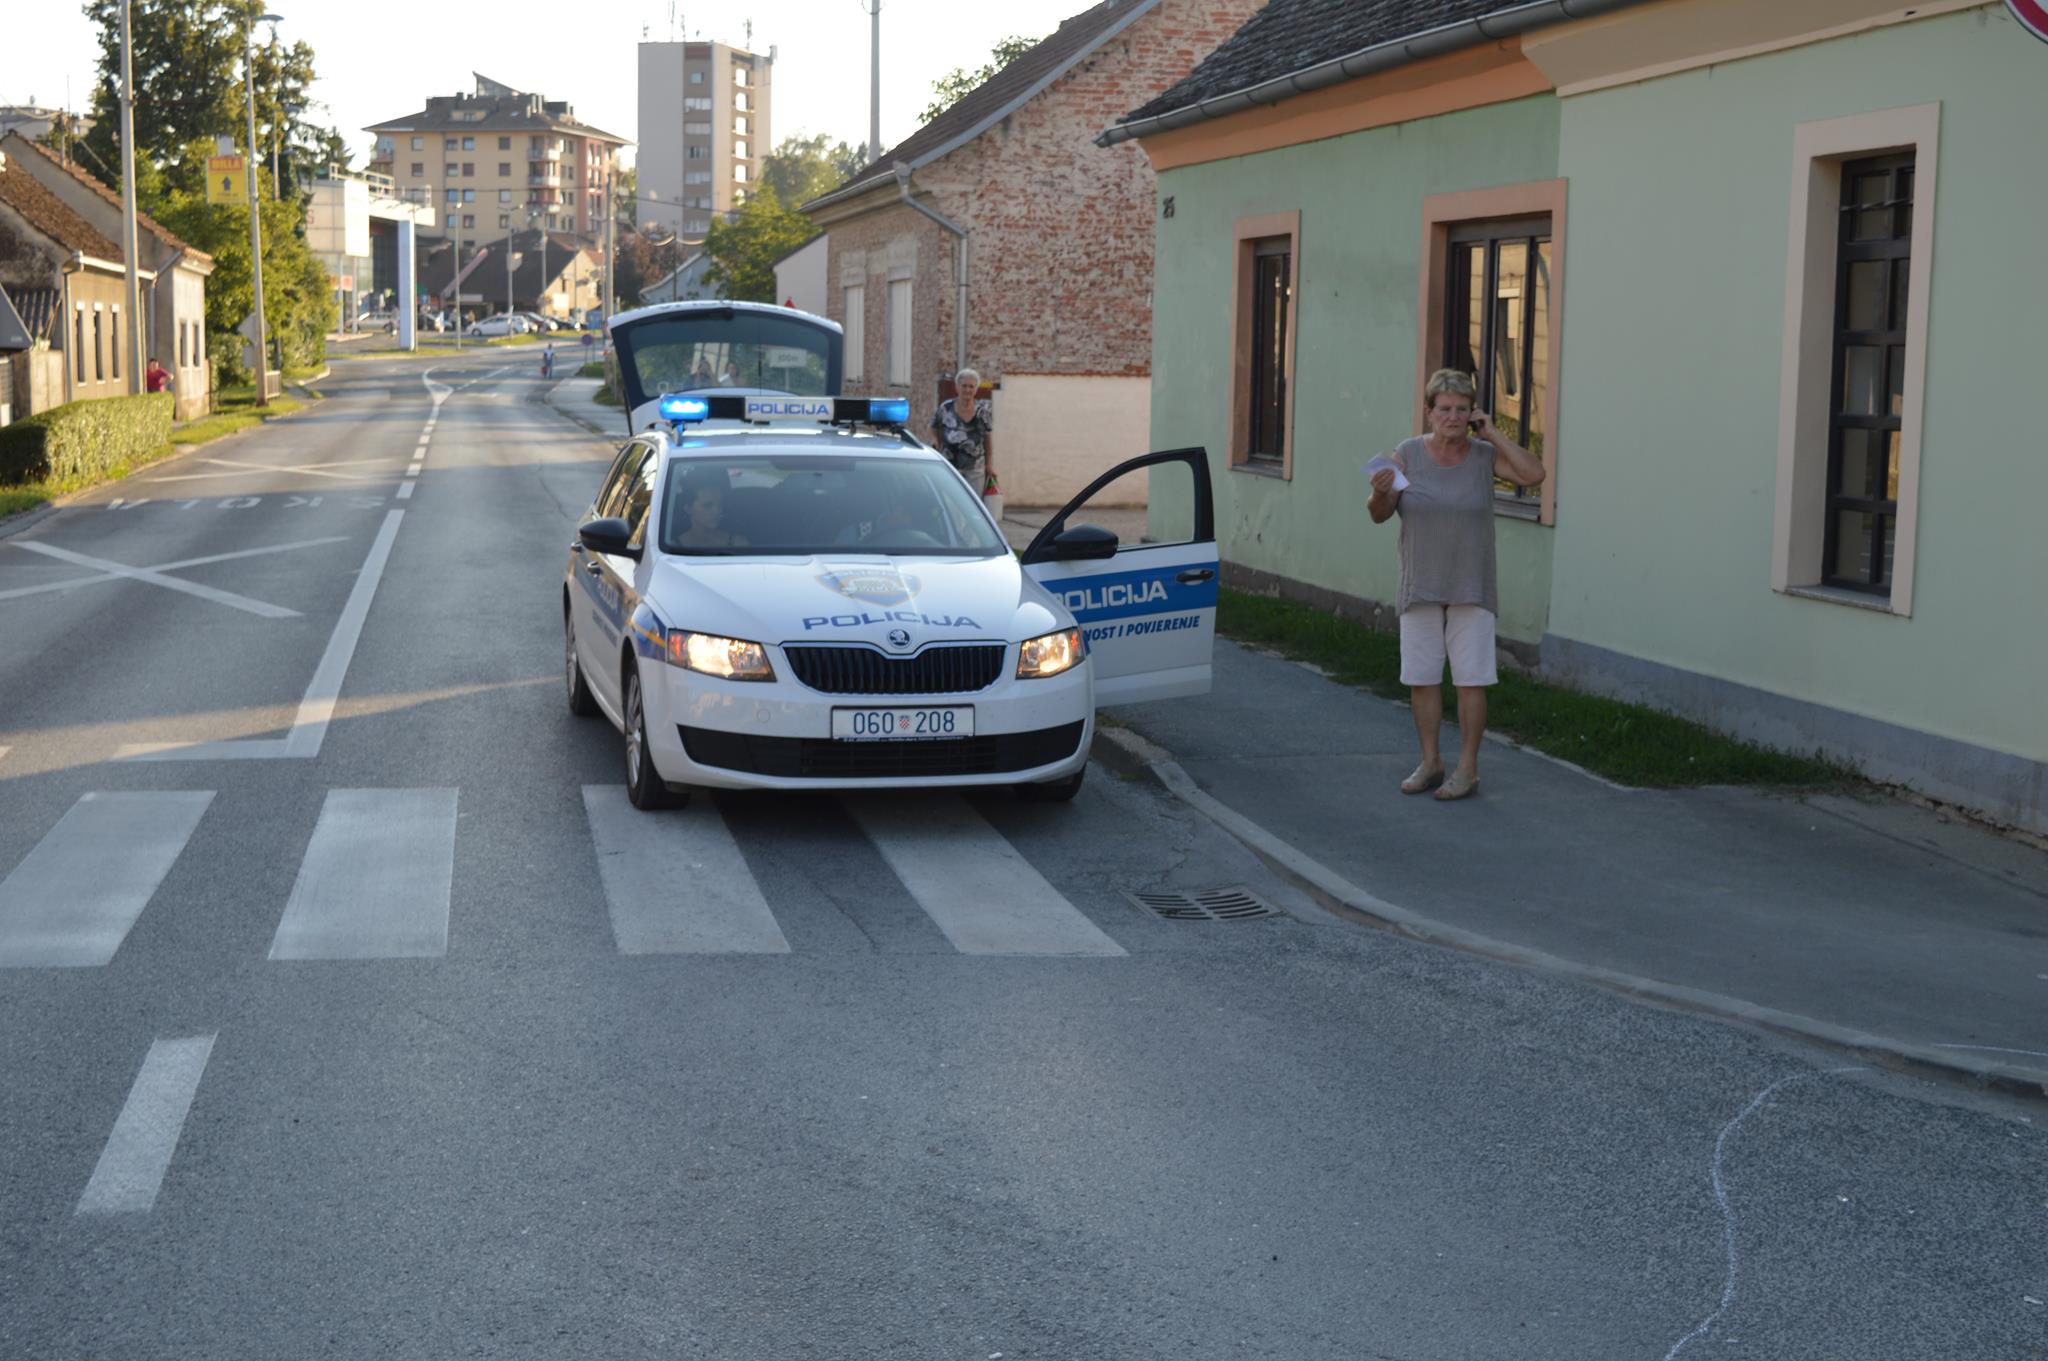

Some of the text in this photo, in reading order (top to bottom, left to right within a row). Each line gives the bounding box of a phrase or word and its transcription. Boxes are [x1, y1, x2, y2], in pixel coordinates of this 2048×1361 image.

[748, 403, 829, 415] POLICIJA
[802, 611, 982, 630] POLICIJA
[1118, 625, 1125, 638] I
[1126, 616, 1200, 636] POVJERENJE
[853, 711, 955, 734] 060 208
